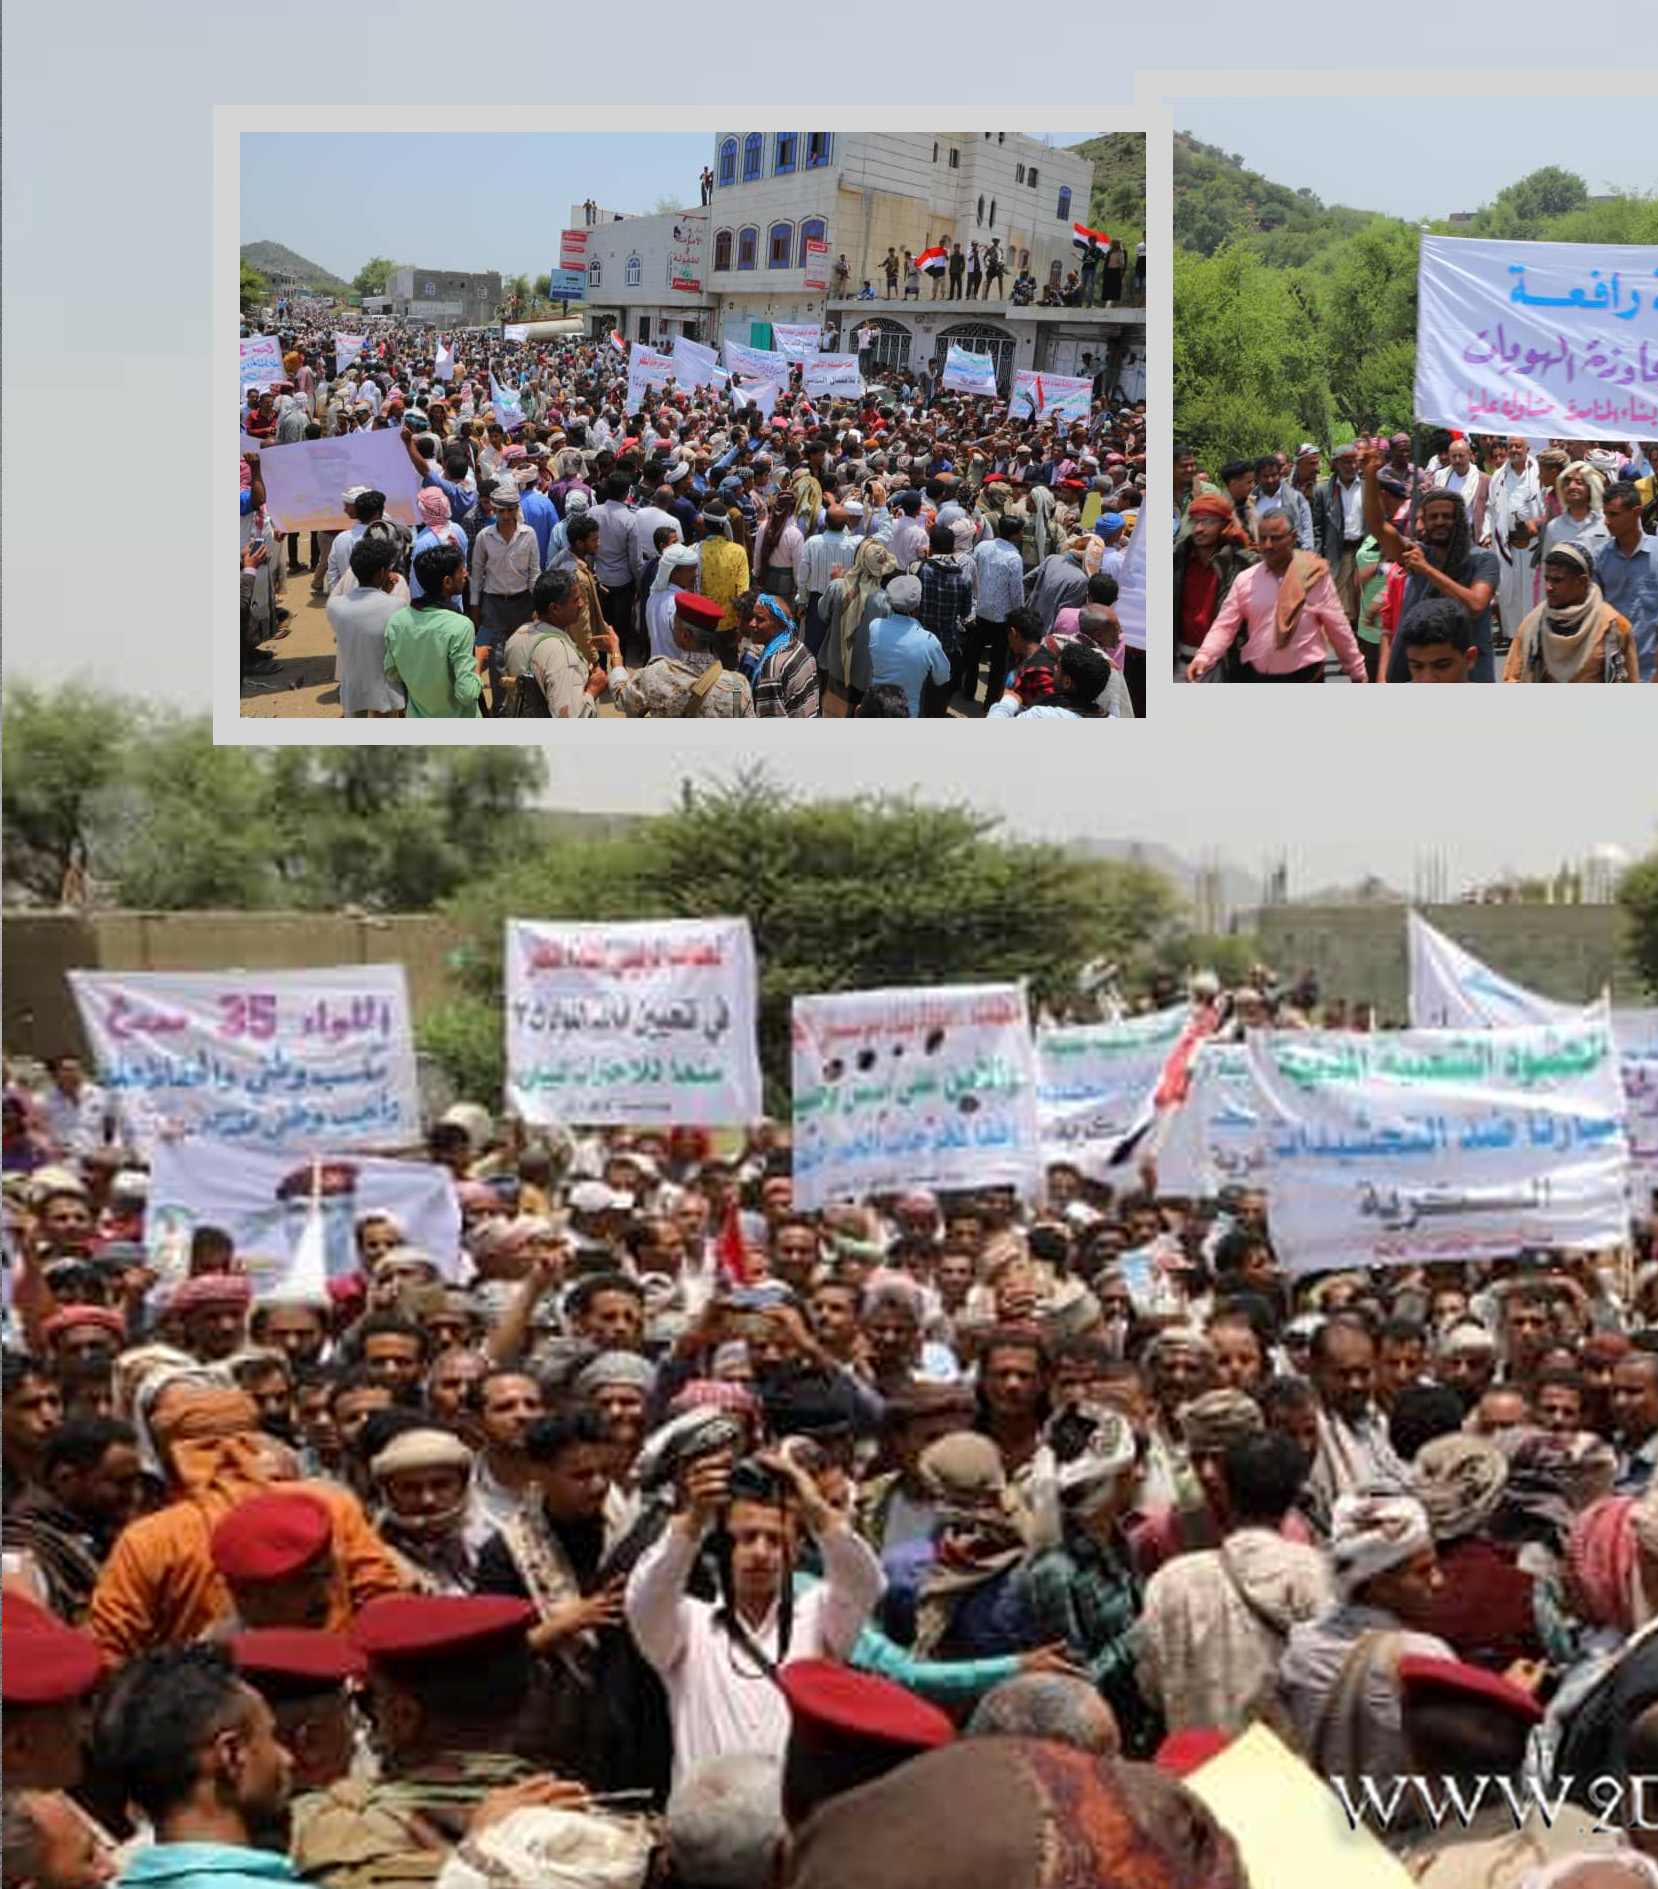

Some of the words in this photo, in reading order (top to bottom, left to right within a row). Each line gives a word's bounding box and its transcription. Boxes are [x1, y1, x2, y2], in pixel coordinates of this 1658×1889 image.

[1507, 264, 1641, 320] رافعة
[1462, 322, 1575, 384] الهويات
[216, 993, 277, 1039] 35
[302, 993, 392, 1044] اللواء
